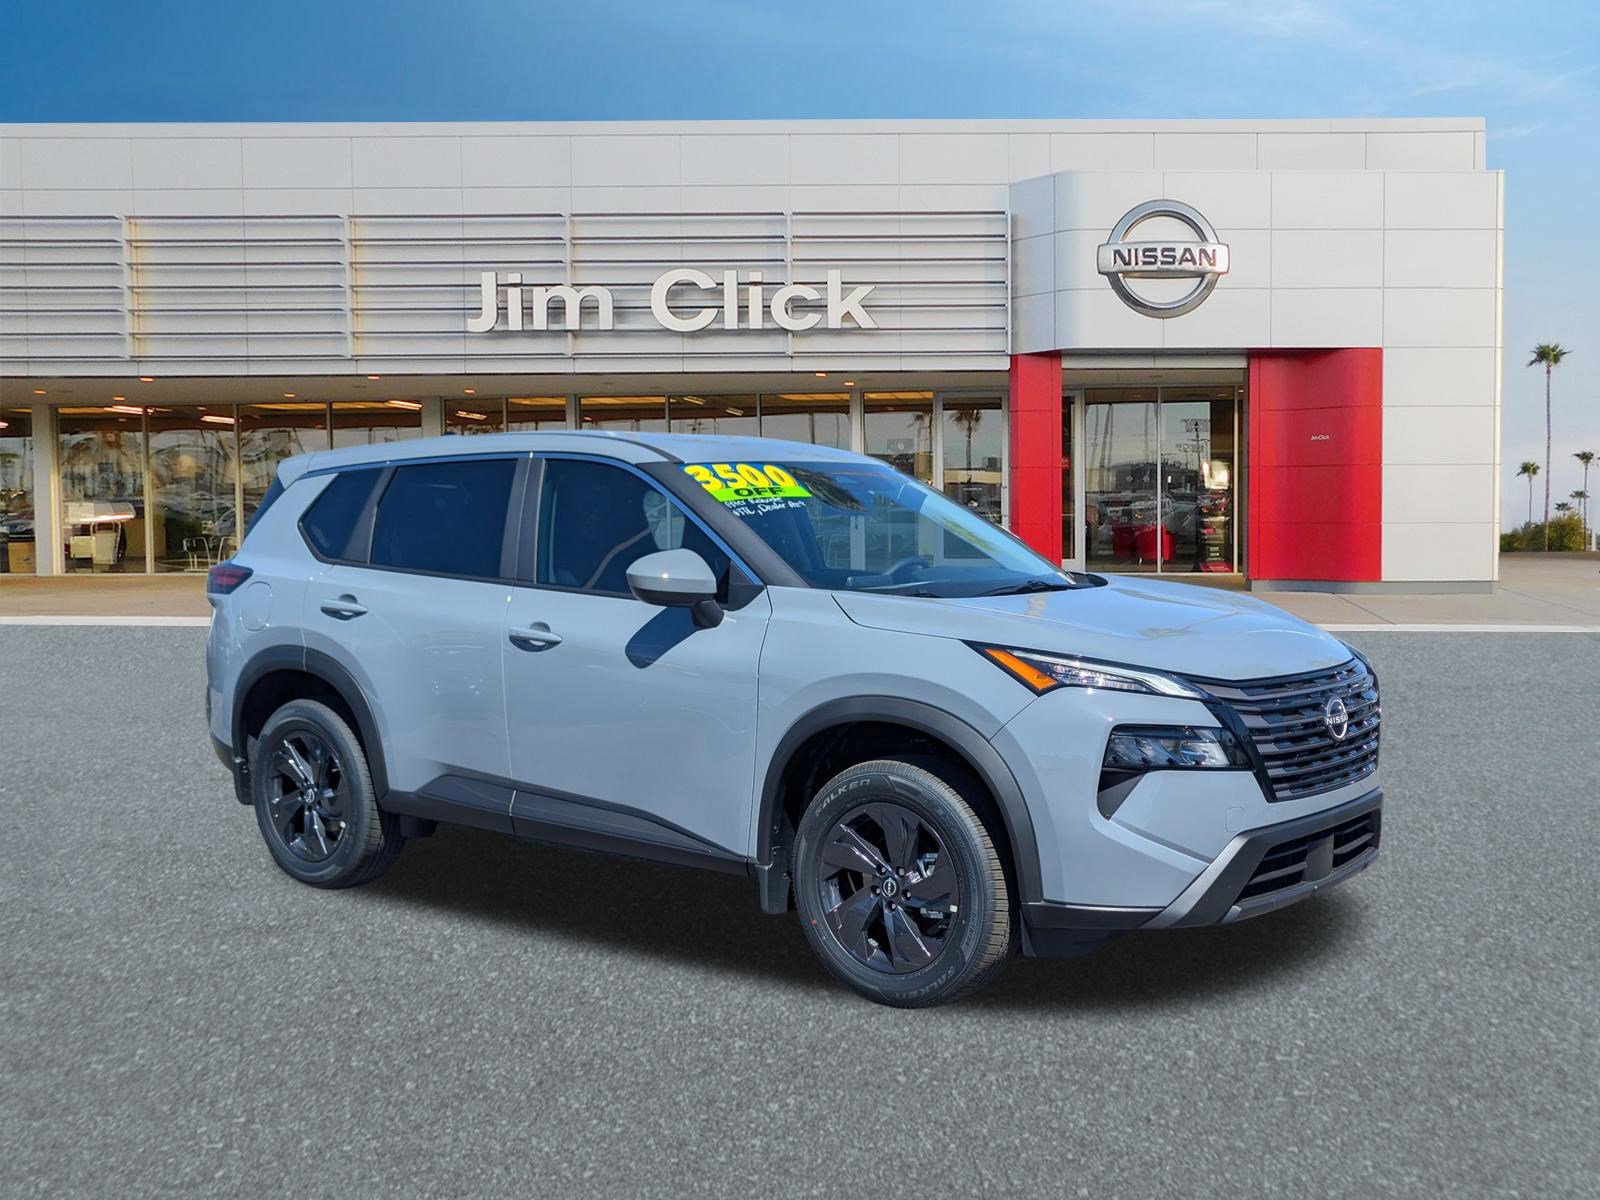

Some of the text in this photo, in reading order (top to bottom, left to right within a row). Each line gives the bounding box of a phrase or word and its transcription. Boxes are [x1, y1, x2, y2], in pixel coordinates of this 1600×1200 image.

[1112, 247, 1217, 266] NISSAN
[467, 268, 879, 333] Jim Click
[684, 463, 799, 492] 3500
[733, 487, 784, 497] OFF
